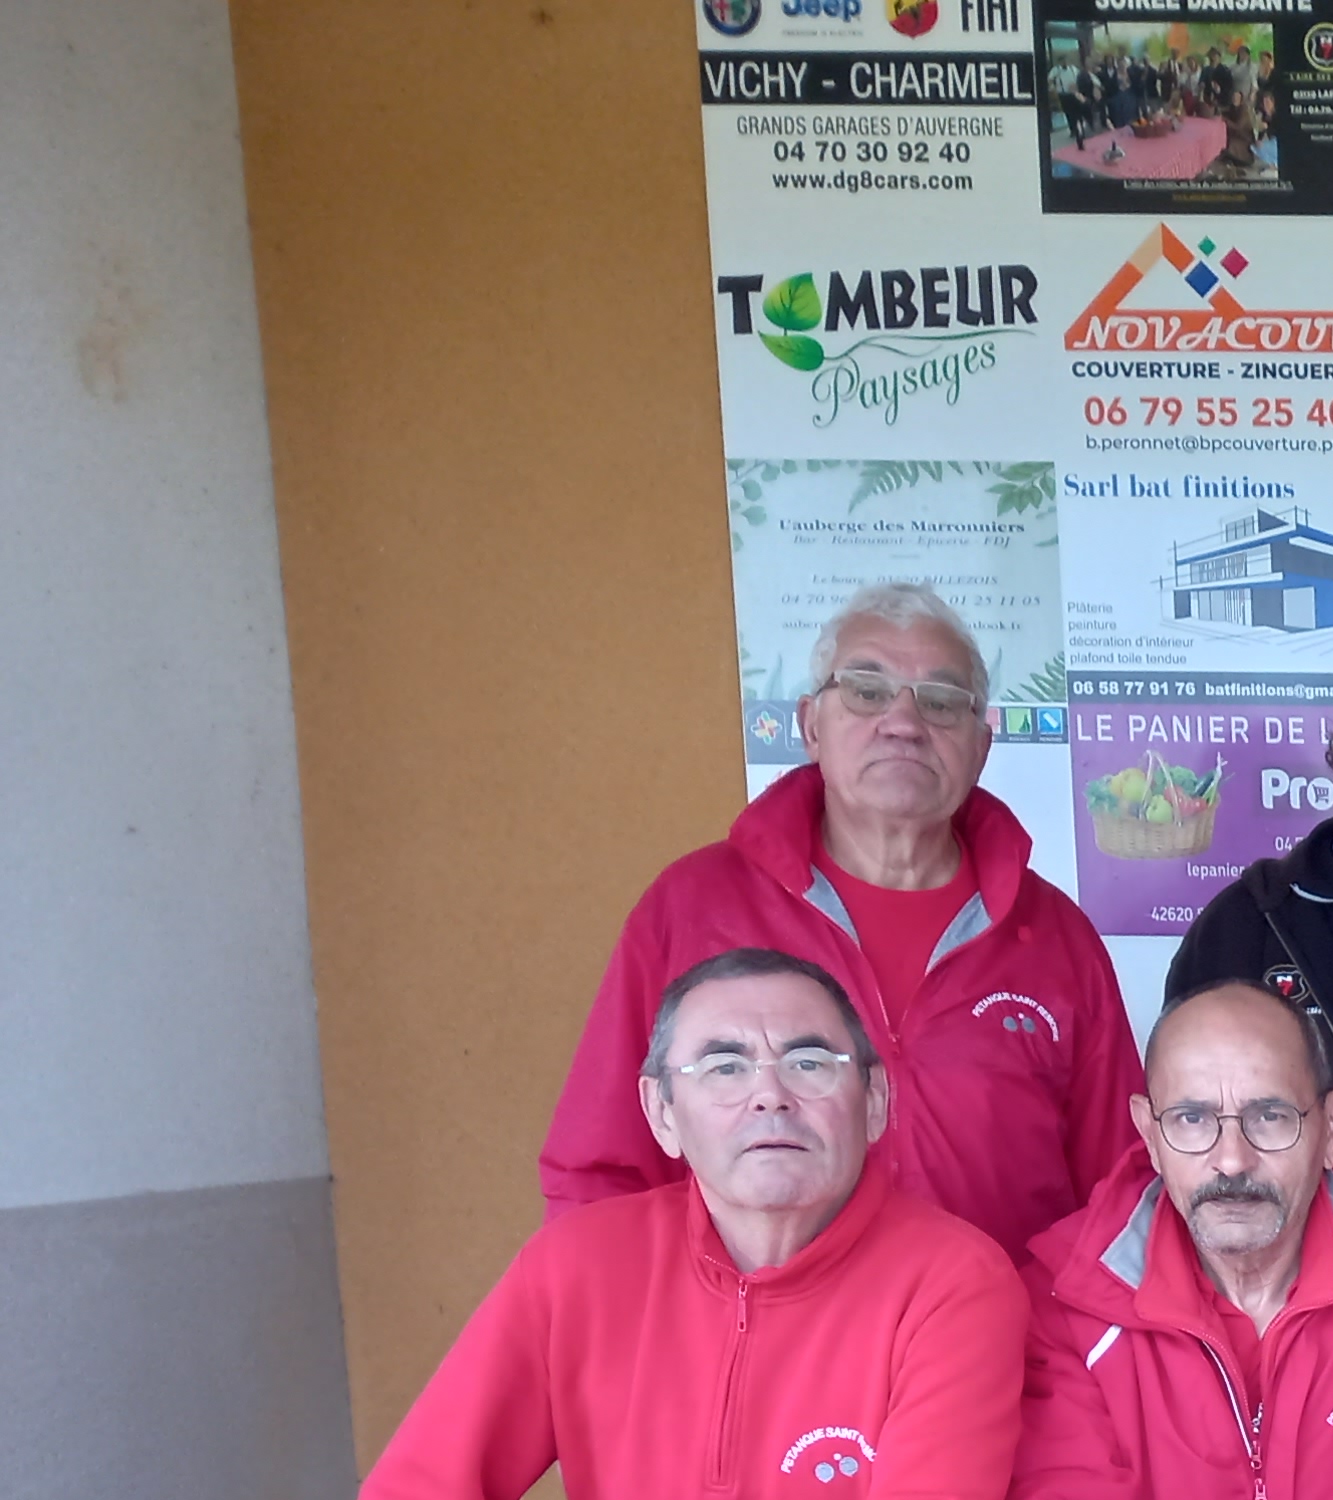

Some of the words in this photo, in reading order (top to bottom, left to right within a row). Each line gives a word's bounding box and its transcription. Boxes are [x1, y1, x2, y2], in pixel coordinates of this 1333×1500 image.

[704, 62, 808, 98] VICHY
[850, 62, 1032, 99] CHARMEIL
[737, 116, 806, 136] GRANDS
[813, 116, 891, 136] GARAGES
[897, 116, 1003, 137] D'AUVERGNE
[774, 141, 805, 162] 04
[815, 141, 846, 162] 70
[856, 142, 888, 162] 30
[898, 142, 930, 163] 92
[939, 142, 970, 163] 40
[773, 171, 973, 193] www.dg8cars.com
[1072, 361, 1221, 379] COUVERTURE
[811, 341, 996, 428] Paysages
[1084, 396, 1127, 426] 06
[1139, 396, 1183, 426] 79
[1196, 397, 1238, 427] 55
[1252, 397, 1293, 427] 25
[1064, 474, 1119, 498] Sarl
[1130, 474, 1172, 498] bat
[1183, 475, 1295, 499] finitions
[873, 520, 904, 531] des
[1068, 602, 1113, 614] Plâterie
[1068, 620, 1117, 631] peinture
[1069, 636, 1132, 647] décoration
[1135, 636, 1194, 648] d'intérieur
[1070, 652, 1114, 665] plafond
[1117, 653, 1142, 664] toile
[1146, 653, 1187, 664] tendue
[1073, 681, 1094, 695] 06
[1099, 681, 1119, 695] 58
[1124, 681, 1145, 695] 77
[1149, 682, 1169, 695] 91
[1175, 682, 1196, 695] 76
[1076, 714, 1114, 742] LE
[1129, 715, 1249, 744] PANIER
[1265, 717, 1305, 744] DE
[1151, 907, 1193, 922] 42620
